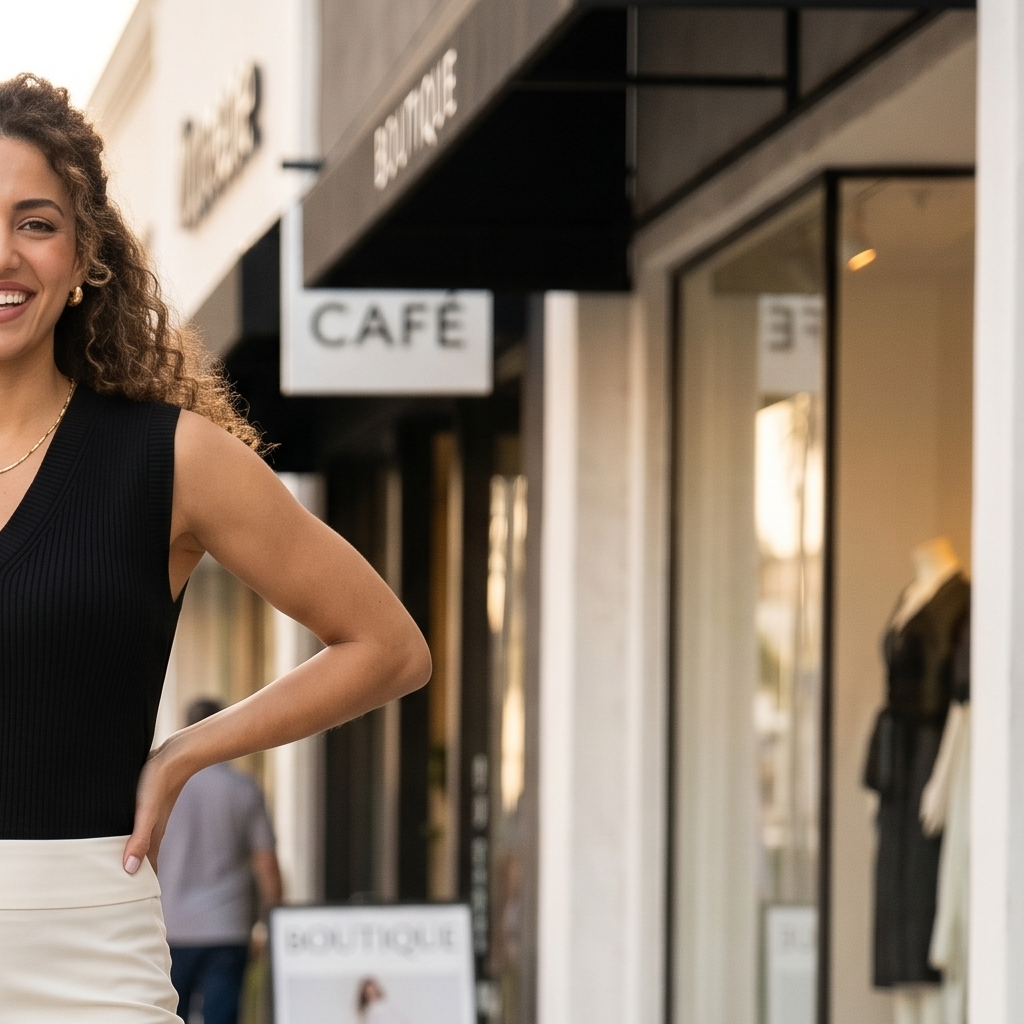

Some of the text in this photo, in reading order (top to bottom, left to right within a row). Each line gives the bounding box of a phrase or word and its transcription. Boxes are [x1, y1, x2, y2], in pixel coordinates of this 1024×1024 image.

[373, 48, 458, 191] BOUTIQUE
[310, 288, 466, 349] CAFÉ
[284, 921, 459, 961] BOUTIQUE
